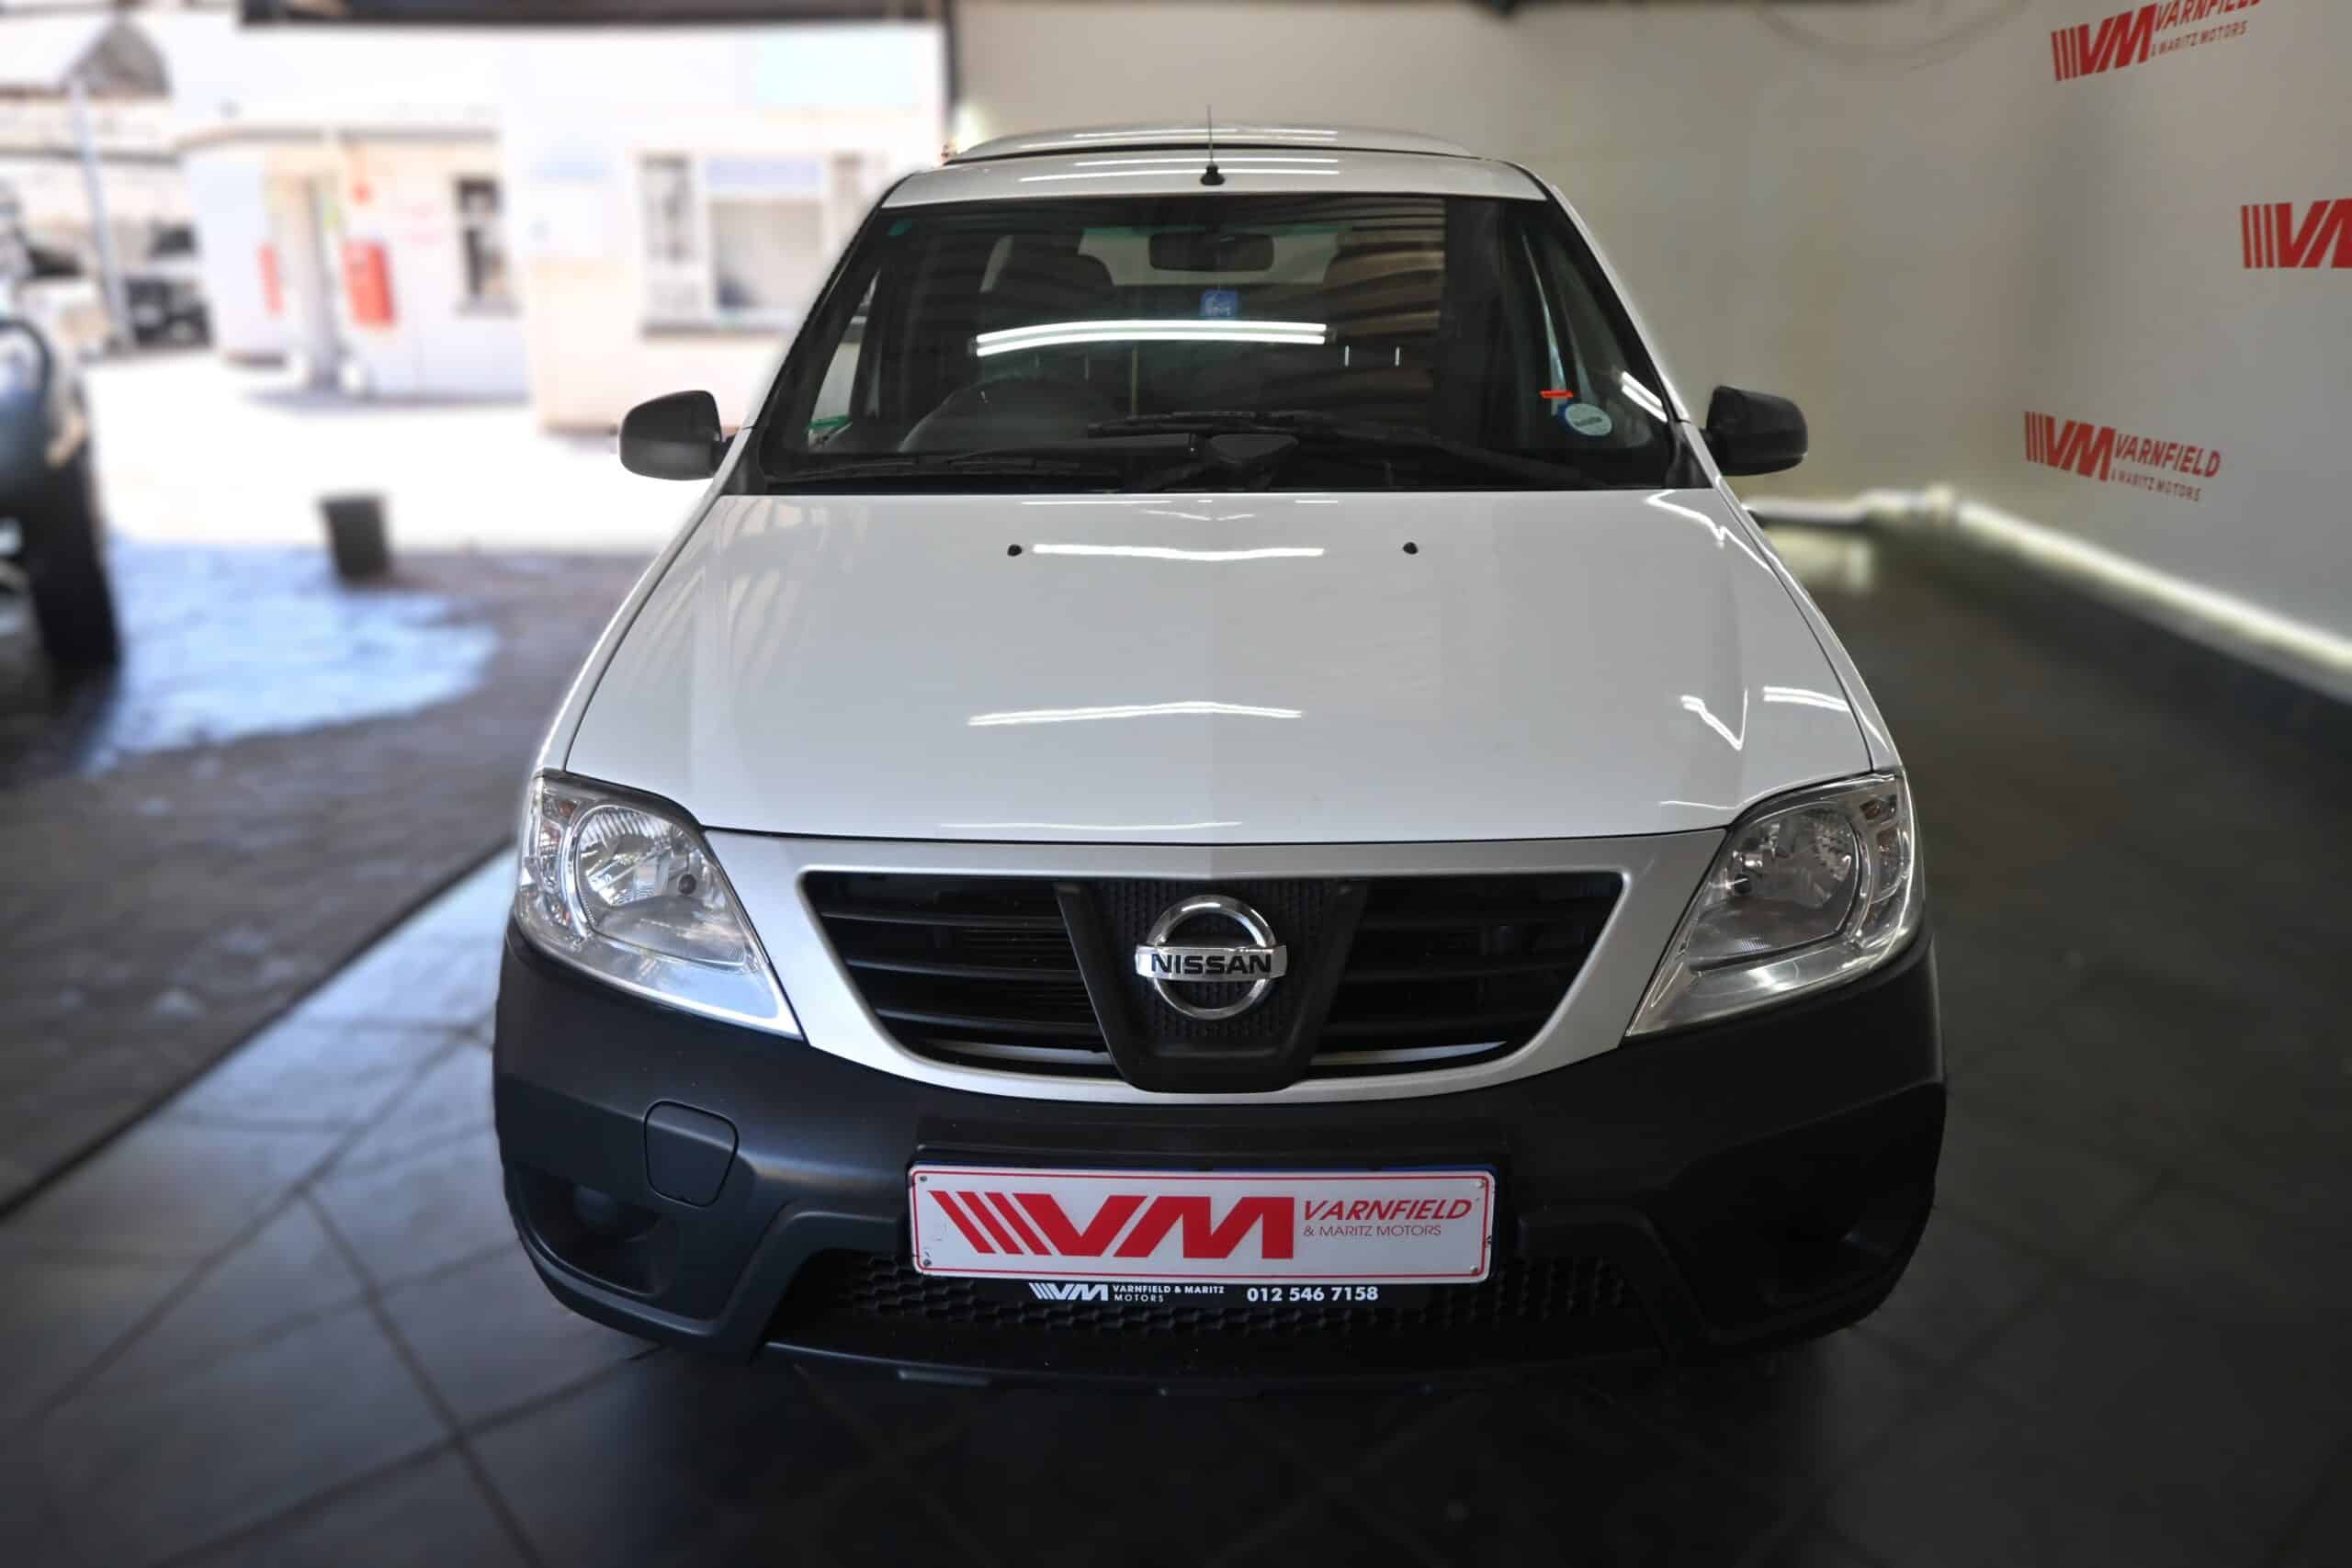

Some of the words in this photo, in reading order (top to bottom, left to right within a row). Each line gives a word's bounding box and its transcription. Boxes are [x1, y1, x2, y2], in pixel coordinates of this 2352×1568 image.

[2200, 20, 2248, 45] MOTORS
[2115, 433, 2222, 479] VARNFIELD
[1150, 953, 1272, 976] NISSAN
[1305, 1199, 1472, 1221] VARNFIELD
[1012, 1190, 1295, 1259] VM
[1303, 1224, 1316, 1236] &
[1319, 1224, 1374, 1237] MARITZ
[1376, 1224, 1442, 1236] MOTORS
[1112, 1284, 1171, 1294] VARNFIELD
[1174, 1285, 1182, 1294] &
[1184, 1284, 1225, 1294] MARITZ
[1114, 1294, 1164, 1303] MOTORS
[1247, 1287, 1283, 1302] 012
[1289, 1287, 1325, 1302] 546
[1331, 1286, 1379, 1301] 7158
